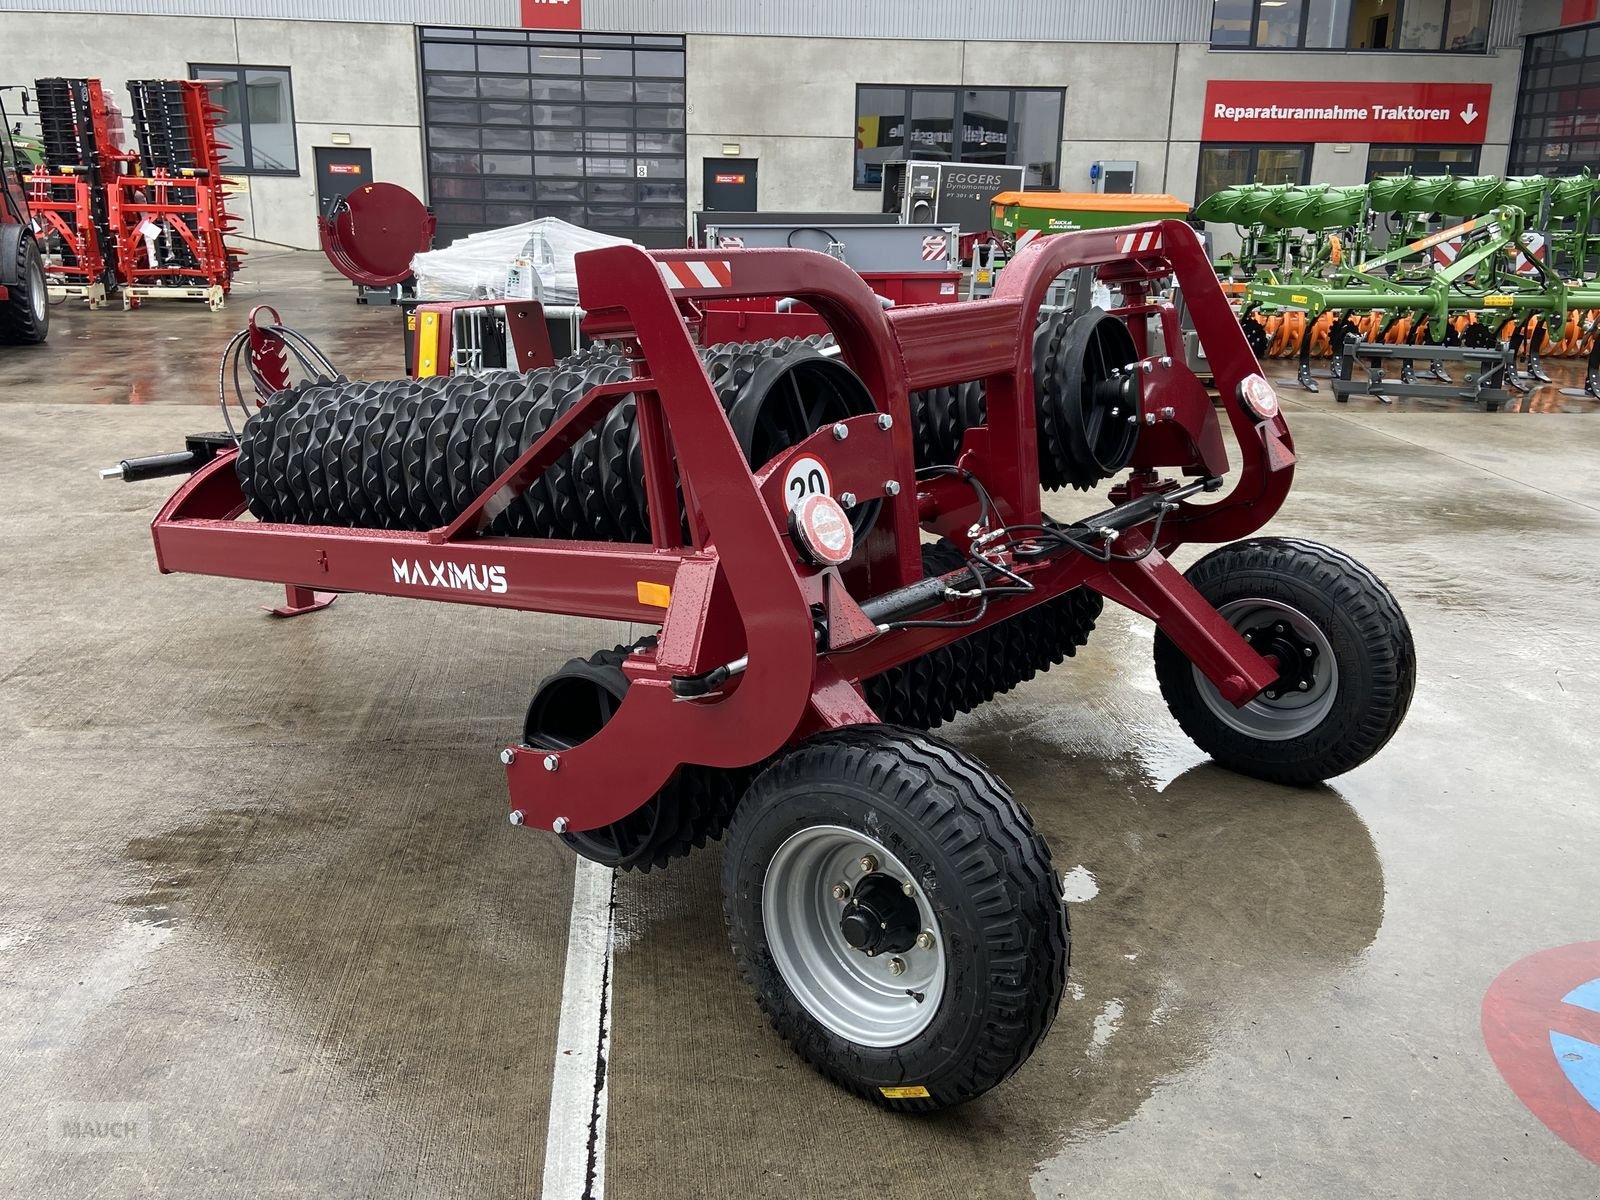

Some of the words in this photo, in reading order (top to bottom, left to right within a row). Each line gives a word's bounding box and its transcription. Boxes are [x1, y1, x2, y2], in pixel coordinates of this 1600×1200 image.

[1214, 104, 1368, 121] Reparaturannahme
[1372, 106, 1450, 120] Traktoren
[638, 167, 646, 176] 8
[947, 173, 1002, 185] EGGERS
[946, 182, 1000, 191] Dynamometer
[790, 469, 825, 499] 20
[391, 557, 508, 594] MAXIMUS
